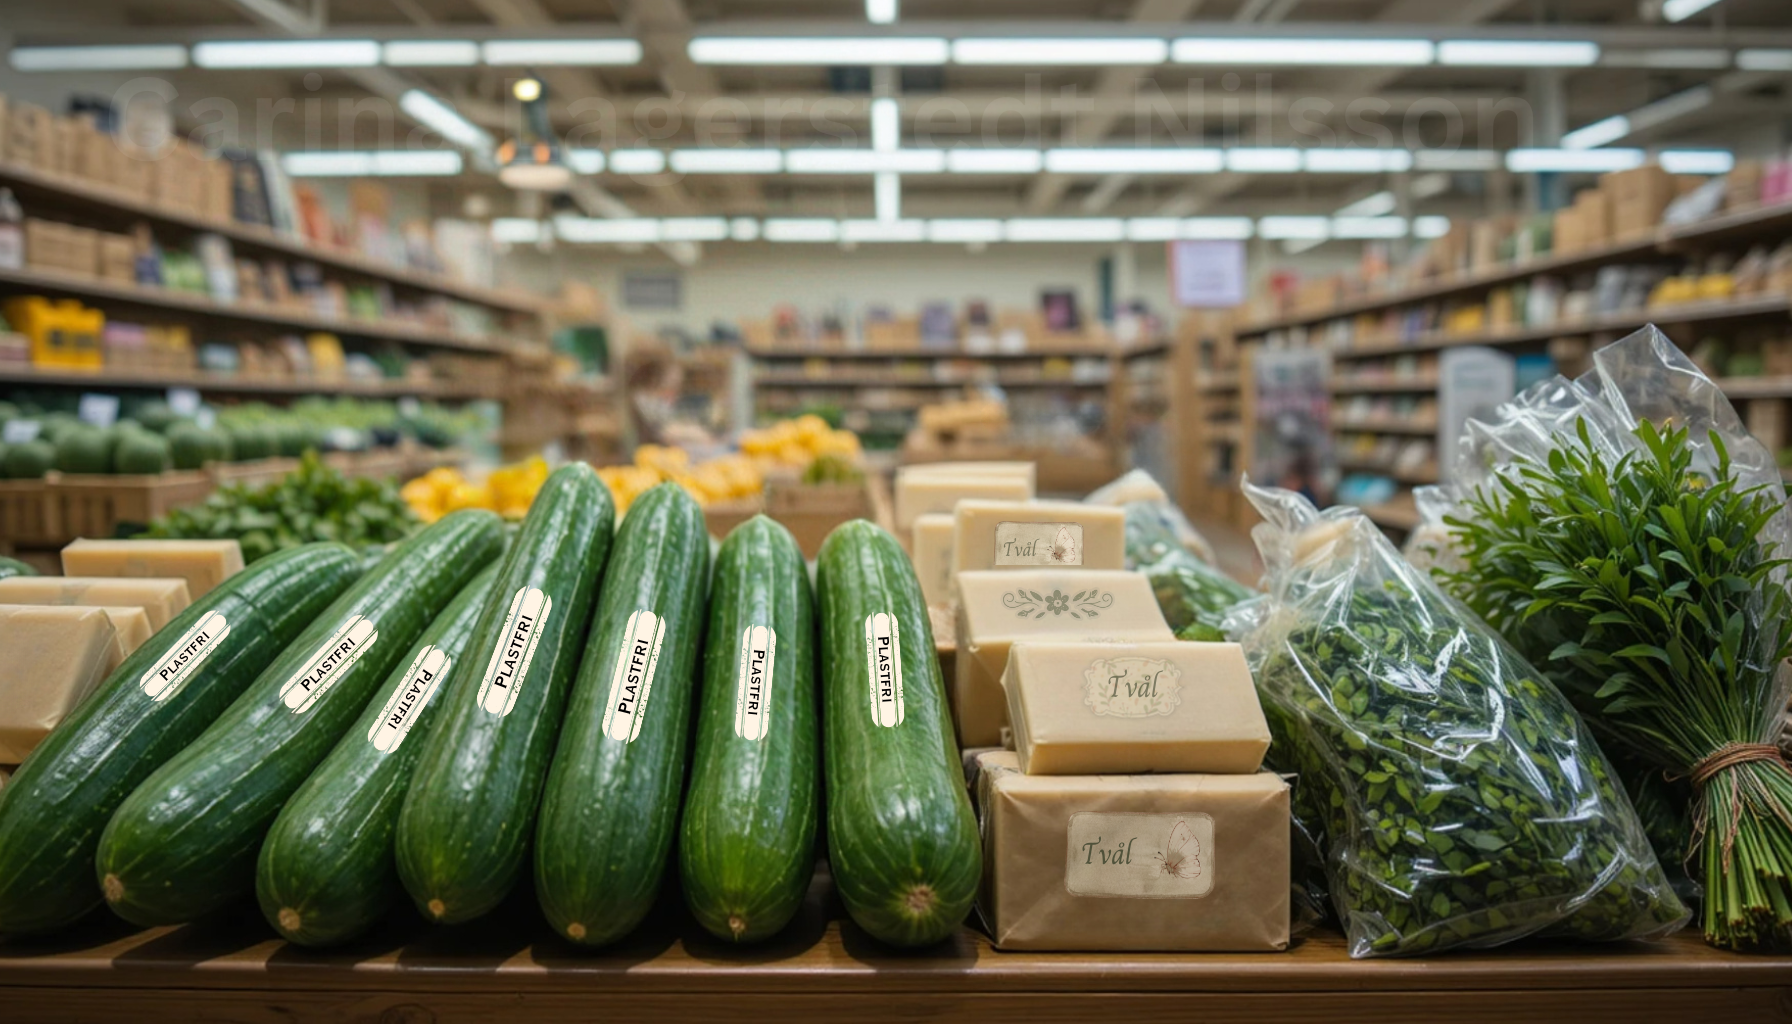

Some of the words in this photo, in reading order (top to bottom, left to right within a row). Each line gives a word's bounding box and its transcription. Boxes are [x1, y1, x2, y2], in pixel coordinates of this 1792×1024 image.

[1003, 537, 1040, 557] Tvål
[160, 631, 211, 682] PLASTFRI
[301, 637, 356, 692] PLASTFRI
[494, 614, 533, 689] PLASTFRI
[618, 639, 649, 715] PLASTFRI
[878, 636, 892, 703] PLASTFRI
[387, 669, 433, 730] PLASTFRI
[747, 649, 765, 716] PLASTFRI
[1107, 669, 1164, 698] Tvål
[1081, 836, 1138, 865] Tvål
